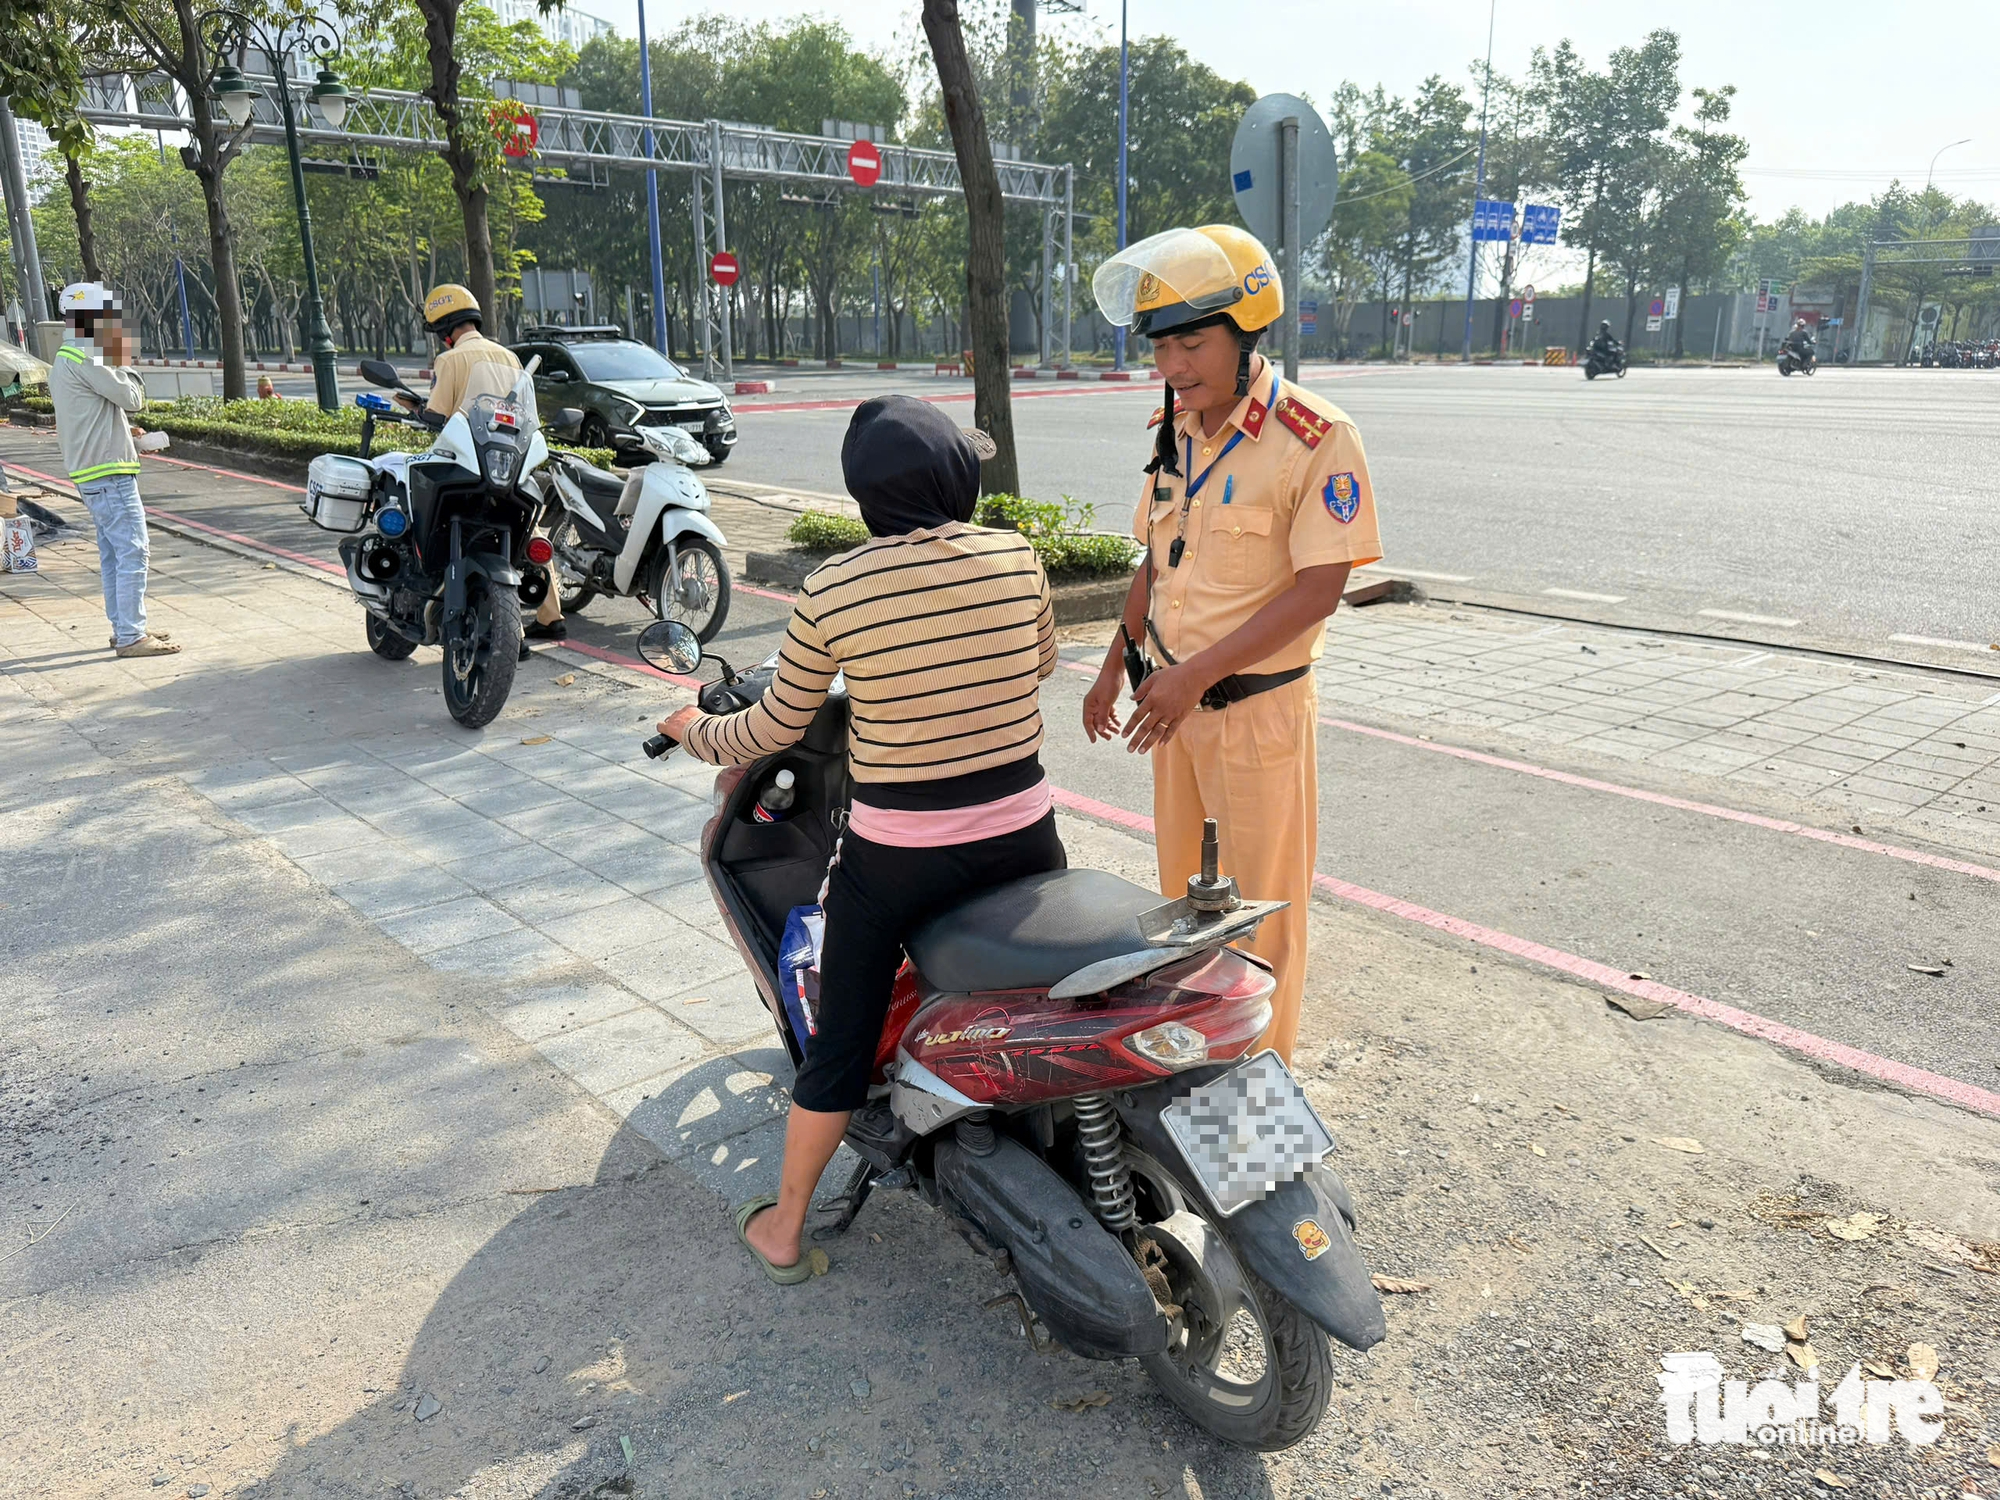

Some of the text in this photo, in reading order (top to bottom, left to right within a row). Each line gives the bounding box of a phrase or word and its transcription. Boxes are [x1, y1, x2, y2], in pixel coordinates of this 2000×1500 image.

[1243, 259, 1277, 296] CSG
[428, 294, 453, 312] CSGT
[405, 454, 435, 465] CSGT
